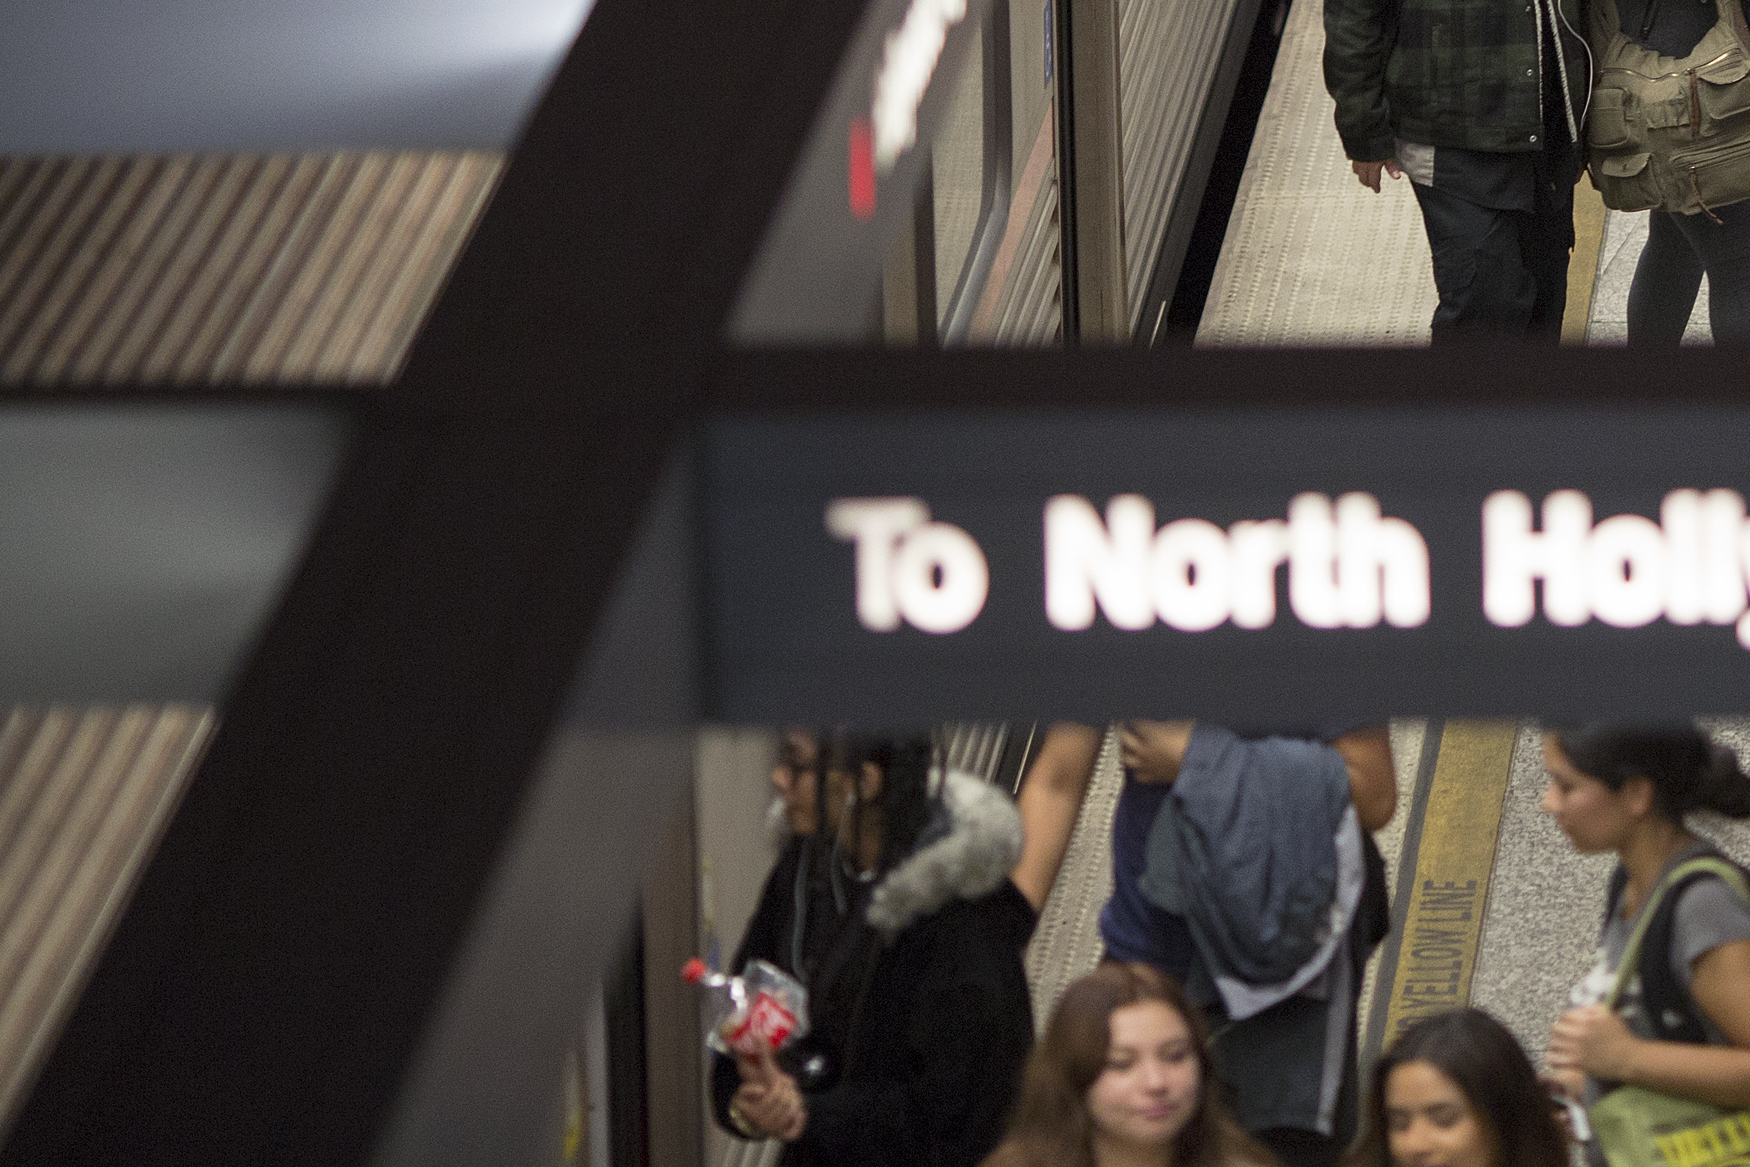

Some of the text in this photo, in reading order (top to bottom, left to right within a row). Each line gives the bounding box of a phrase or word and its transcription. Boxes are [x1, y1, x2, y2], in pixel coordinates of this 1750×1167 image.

[829, 497, 988, 633] To
[1044, 492, 1430, 631] North
[1417, 879, 1477, 922] LINE
[1400, 926, 1467, 1009] YELLOW
